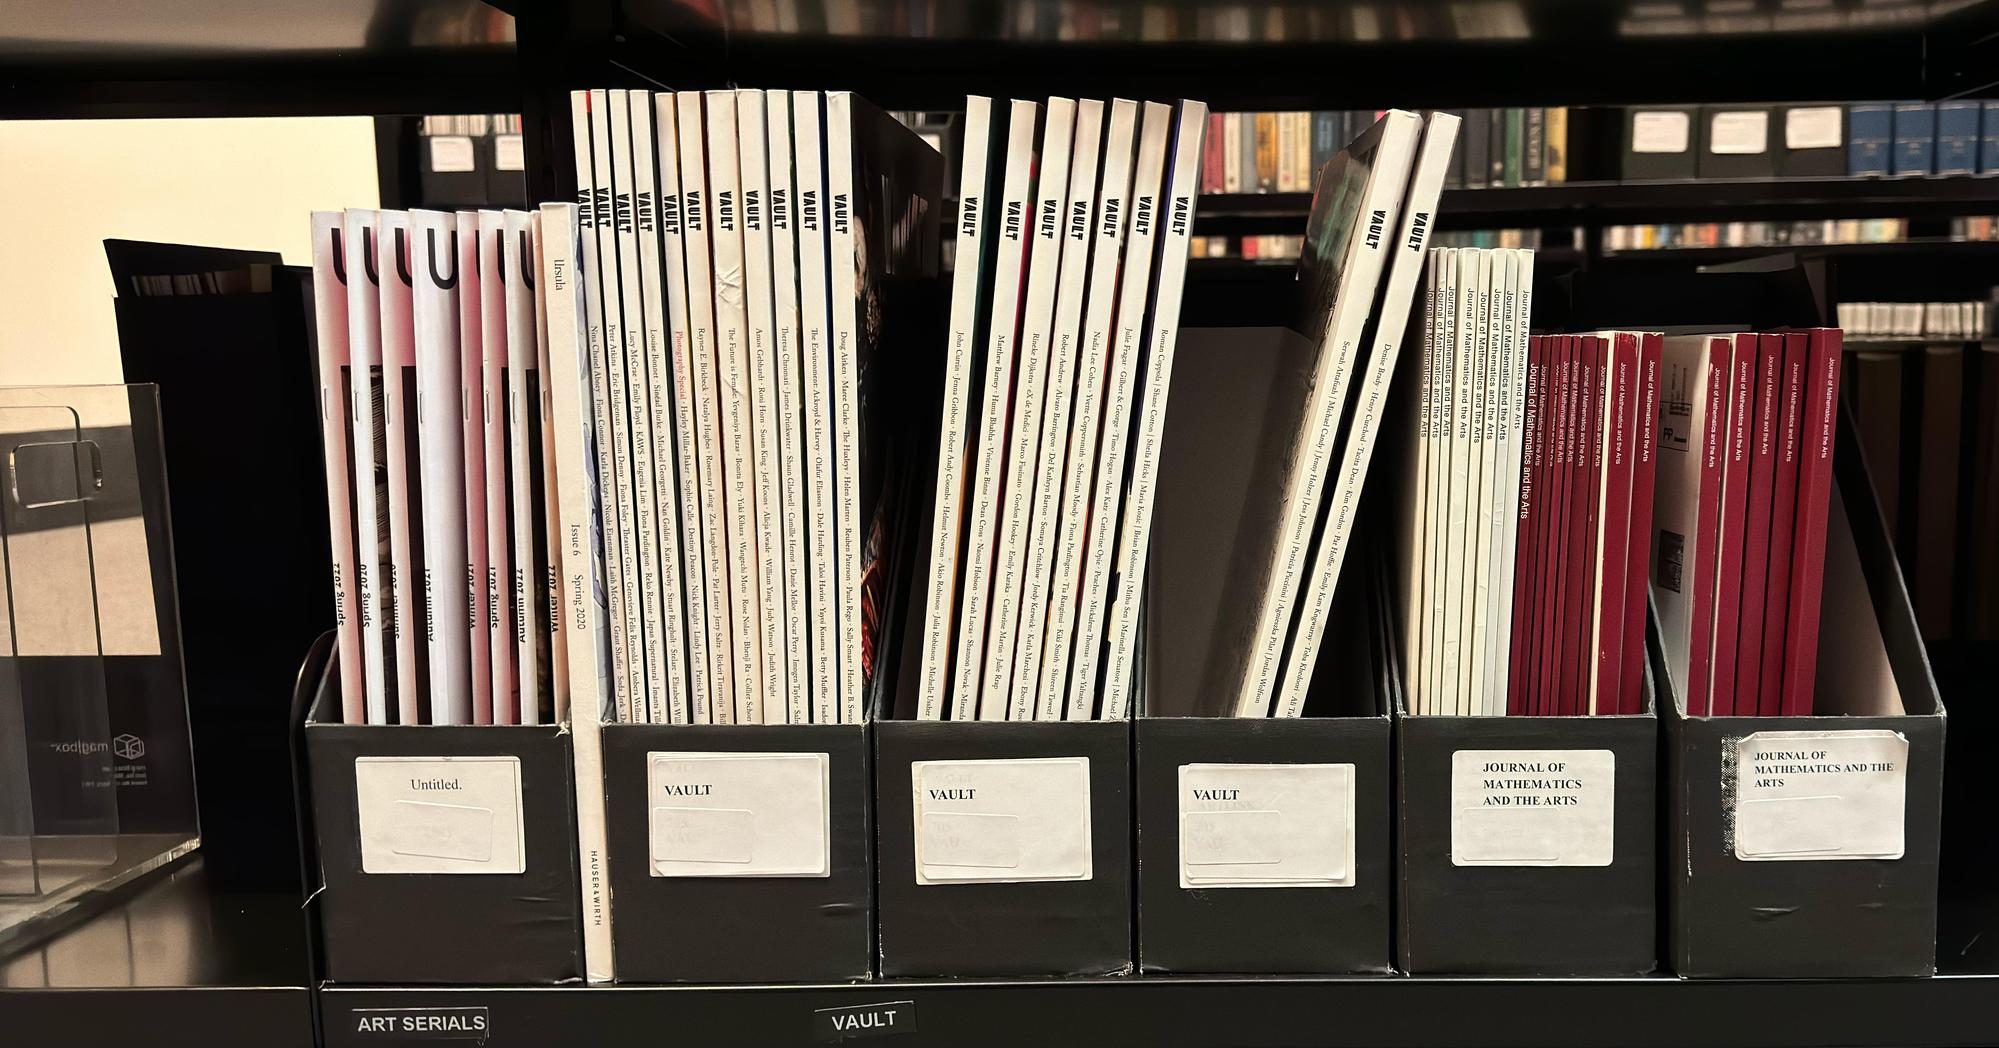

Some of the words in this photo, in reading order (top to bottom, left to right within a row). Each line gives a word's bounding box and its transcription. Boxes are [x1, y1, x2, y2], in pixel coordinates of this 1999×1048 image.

[617, 194, 631, 233] VAULT
[638, 192, 652, 231] VAULT
[664, 195, 678, 234] VAULT
[687, 191, 701, 231] VAULT
[719, 192, 733, 231] VAULT
[746, 190, 760, 230] VAULT
[773, 189, 786, 229] VAULT
[804, 191, 817, 231] VAULT
[835, 194, 848, 234] VAULT
[963, 197, 978, 237] VAULT
[1005, 201, 1021, 240] VAULT
[1041, 200, 1057, 239] VAULT
[1070, 201, 1087, 240] VAULT
[1103, 198, 1119, 238] VAULT
[1136, 196, 1152, 235] VAULT
[1172, 197, 1189, 236] VAULT
[1366, 210, 1386, 250] VAULT
[1408, 212, 1428, 252] VAULT
[427, 228, 458, 290] U
[554, 260, 566, 290] Ursula
[1437, 288, 1445, 319] Journal
[1466, 287, 1474, 319] Journal
[1492, 288, 1501, 319] Journal
[1521, 290, 1529, 318] Journal
[590, 325, 598, 342] Nina
[1436, 321, 1443, 329] of
[1465, 321, 1472, 330] of
[1492, 322, 1499, 330] of
[1520, 320, 1527, 329] of
[955, 330, 964, 347] John
[1060, 333, 1069, 356] Robert
[591, 344, 600, 369] Chanel
[675, 331, 684, 374] Photography
[954, 349, 962, 371] Currin
[1434, 332, 1443, 385] Mathematics
[1462, 333, 1472, 385] Mathematics
[1489, 333, 1498, 386] Mathematics
[1517, 330, 1526, 380] Mathematics
[1057, 357, 1066, 384] Andrew
[1528, 363, 1538, 396] Journal
[1619, 362, 1627, 384] Journal
[1740, 360, 1748, 382] Journal
[1828, 357, 1836, 379] Journal
[593, 370, 601, 392] Abney
[676, 375, 686, 399] Special
[701, 397, 710, 422] Natalya
[1487, 407, 1495, 420] the
[1527, 398, 1536, 407] of
[1617, 392, 1625, 428] Mathematics
[1737, 390, 1746, 425] Mathematics
[1824, 387, 1833, 422] Mathematics
[702, 424, 712, 449] Hughes
[1431, 421, 1439, 438] Arts
[1459, 421, 1467, 438] Arts
[1486, 422, 1494, 439] Arts
[1523, 409, 1535, 464] Mathematics
[635, 431, 644, 454] KAWS
[1735, 449, 1743, 460] Arts
[1522, 466, 1531, 483] and
[619, 484, 627, 502] Fiona
[786, 477, 794, 506] Gladwell
[1104, 479, 1112, 495] Alex
[1138, 484, 1147, 504] Maria
[1343, 489, 1352, 503] Kim
[1521, 485, 1530, 499] the
[620, 504, 628, 522] Foley
[979, 500, 988, 517] Dean
[1012, 493, 1022, 518] Gordon
[1102, 496, 1111, 511] Katz
[1135, 505, 1144, 524] Kozic
[1301, 500, 1310, 513] Jess
[1520, 500, 1529, 518] Arts
[978, 519, 986, 537] Cross
[1294, 514, 1307, 540] Johnson
[1336, 505, 1348, 529] Gordon
[571, 524, 580, 548] Issue
[815, 529, 824, 556] Harding
[1008, 519, 1019, 545] Hookey
[663, 547, 671, 562] Kate
[664, 564, 673, 587] Newby
[572, 575, 584, 605] Spring
[576, 608, 586, 629] 2020
[646, 619, 655, 638] Japan
[1055, 628, 1063, 642] Kiki
[647, 639, 658, 680] Supernatural
[767, 652, 775, 672] Judith
[1052, 643, 1062, 662] Smith
[767, 673, 776, 696] Wright
[1483, 762, 1544, 774] JOURNAL
[1547, 762, 1566, 773] OF
[1755, 752, 1810, 762] JOURNAL
[1813, 751, 1826, 761] OF
[1755, 764, 1841, 775] MATHEMATICS
[1844, 763, 1866, 774] AND
[1870, 762, 1894, 773] THE
[411, 778, 462, 791] Untitled.
[665, 785, 712, 796] VAULT
[929, 789, 976, 800] VAULT
[1193, 789, 1239, 800] VAULT
[1483, 779, 1582, 790] MATHEMATICS
[1754, 778, 1784, 788] ARTS
[1483, 795, 1509, 806] AND
[1514, 795, 1540, 806] THE
[1544, 795, 1578, 806] ARTS
[591, 851, 599, 888] HAUSER
[358, 1016, 395, 1032] ART
[402, 1015, 486, 1032] SERIALS
[832, 1010, 896, 1031] VAULT
